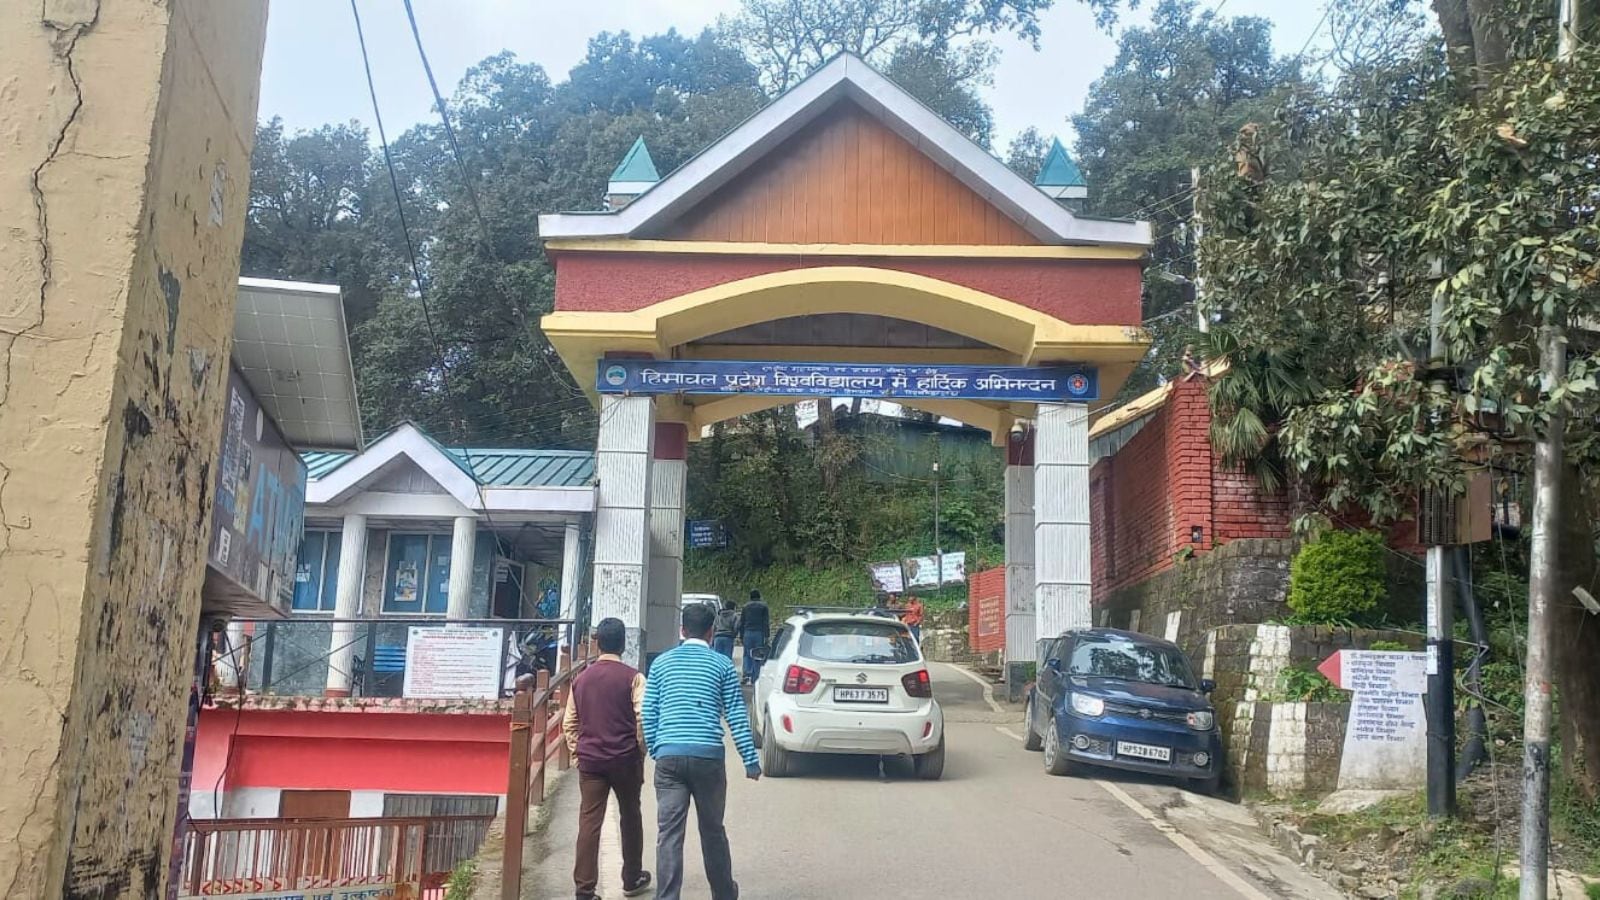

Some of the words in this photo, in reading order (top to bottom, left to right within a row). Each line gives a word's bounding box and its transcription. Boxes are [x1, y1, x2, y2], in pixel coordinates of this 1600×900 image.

[640, 368, 717, 384] हिमाचल
[723, 371, 767, 387] प्रदेश
[773, 371, 883, 389] विश्वविद्यालय
[916, 373, 968, 391] हार्दिक
[973, 374, 1056, 391] अभिनन्दन
